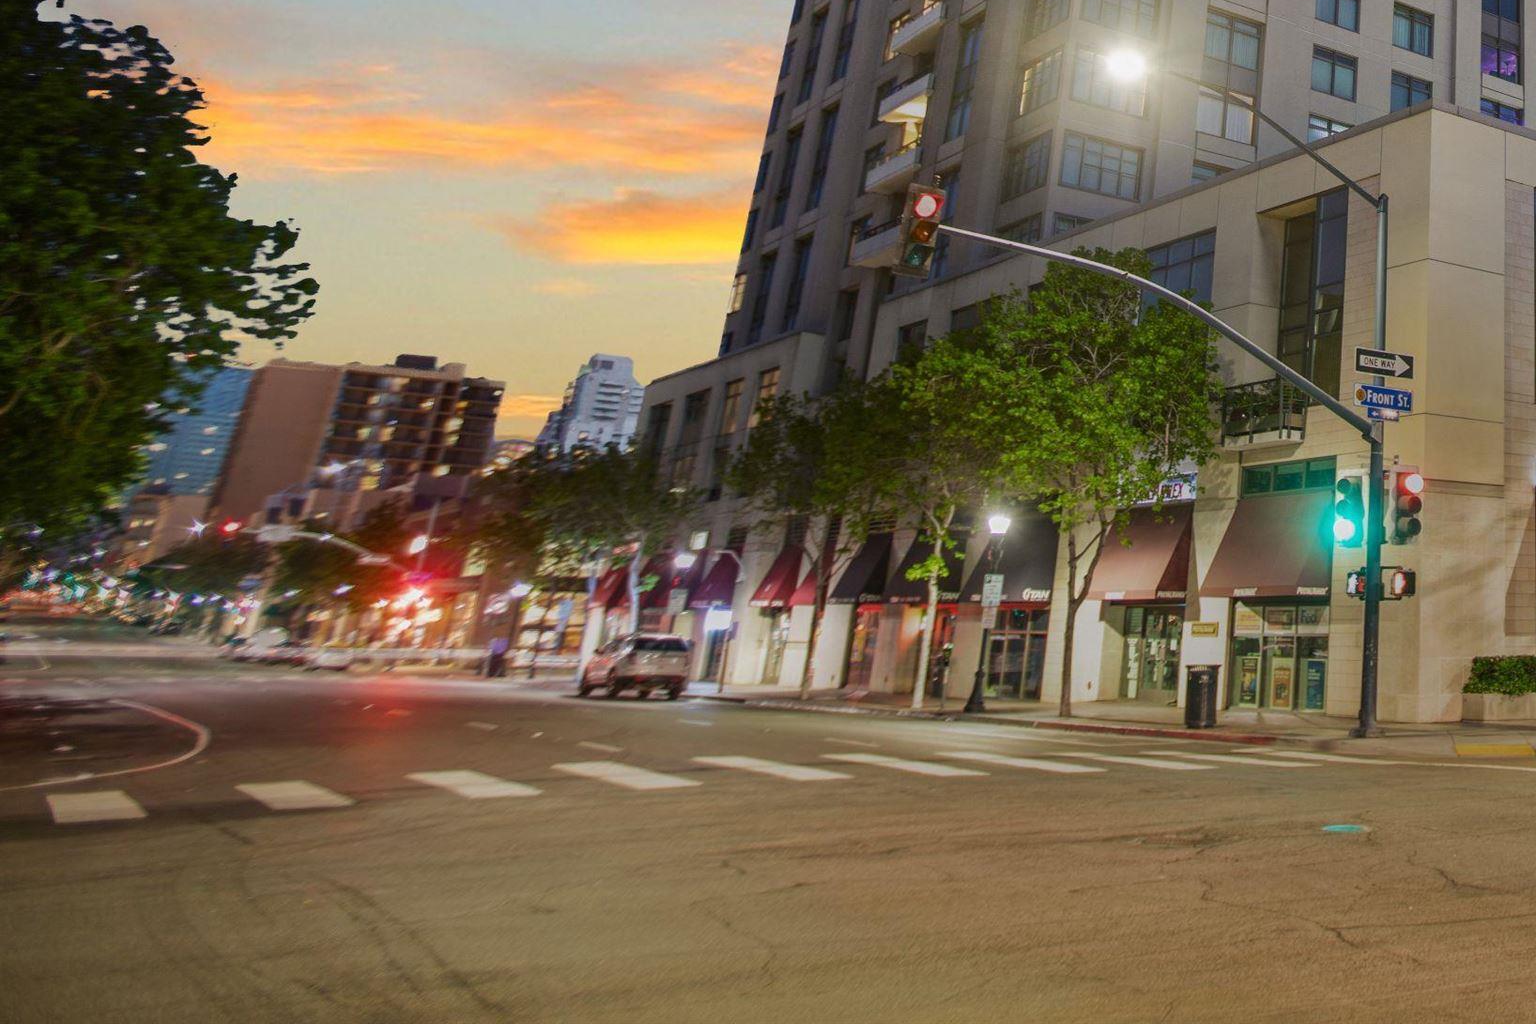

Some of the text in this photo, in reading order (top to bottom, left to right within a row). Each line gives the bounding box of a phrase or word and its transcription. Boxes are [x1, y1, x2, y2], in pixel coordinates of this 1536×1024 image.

[1363, 356, 1396, 369] ONE WAY
[1366, 389, 1410, 408] FRONT ST.
